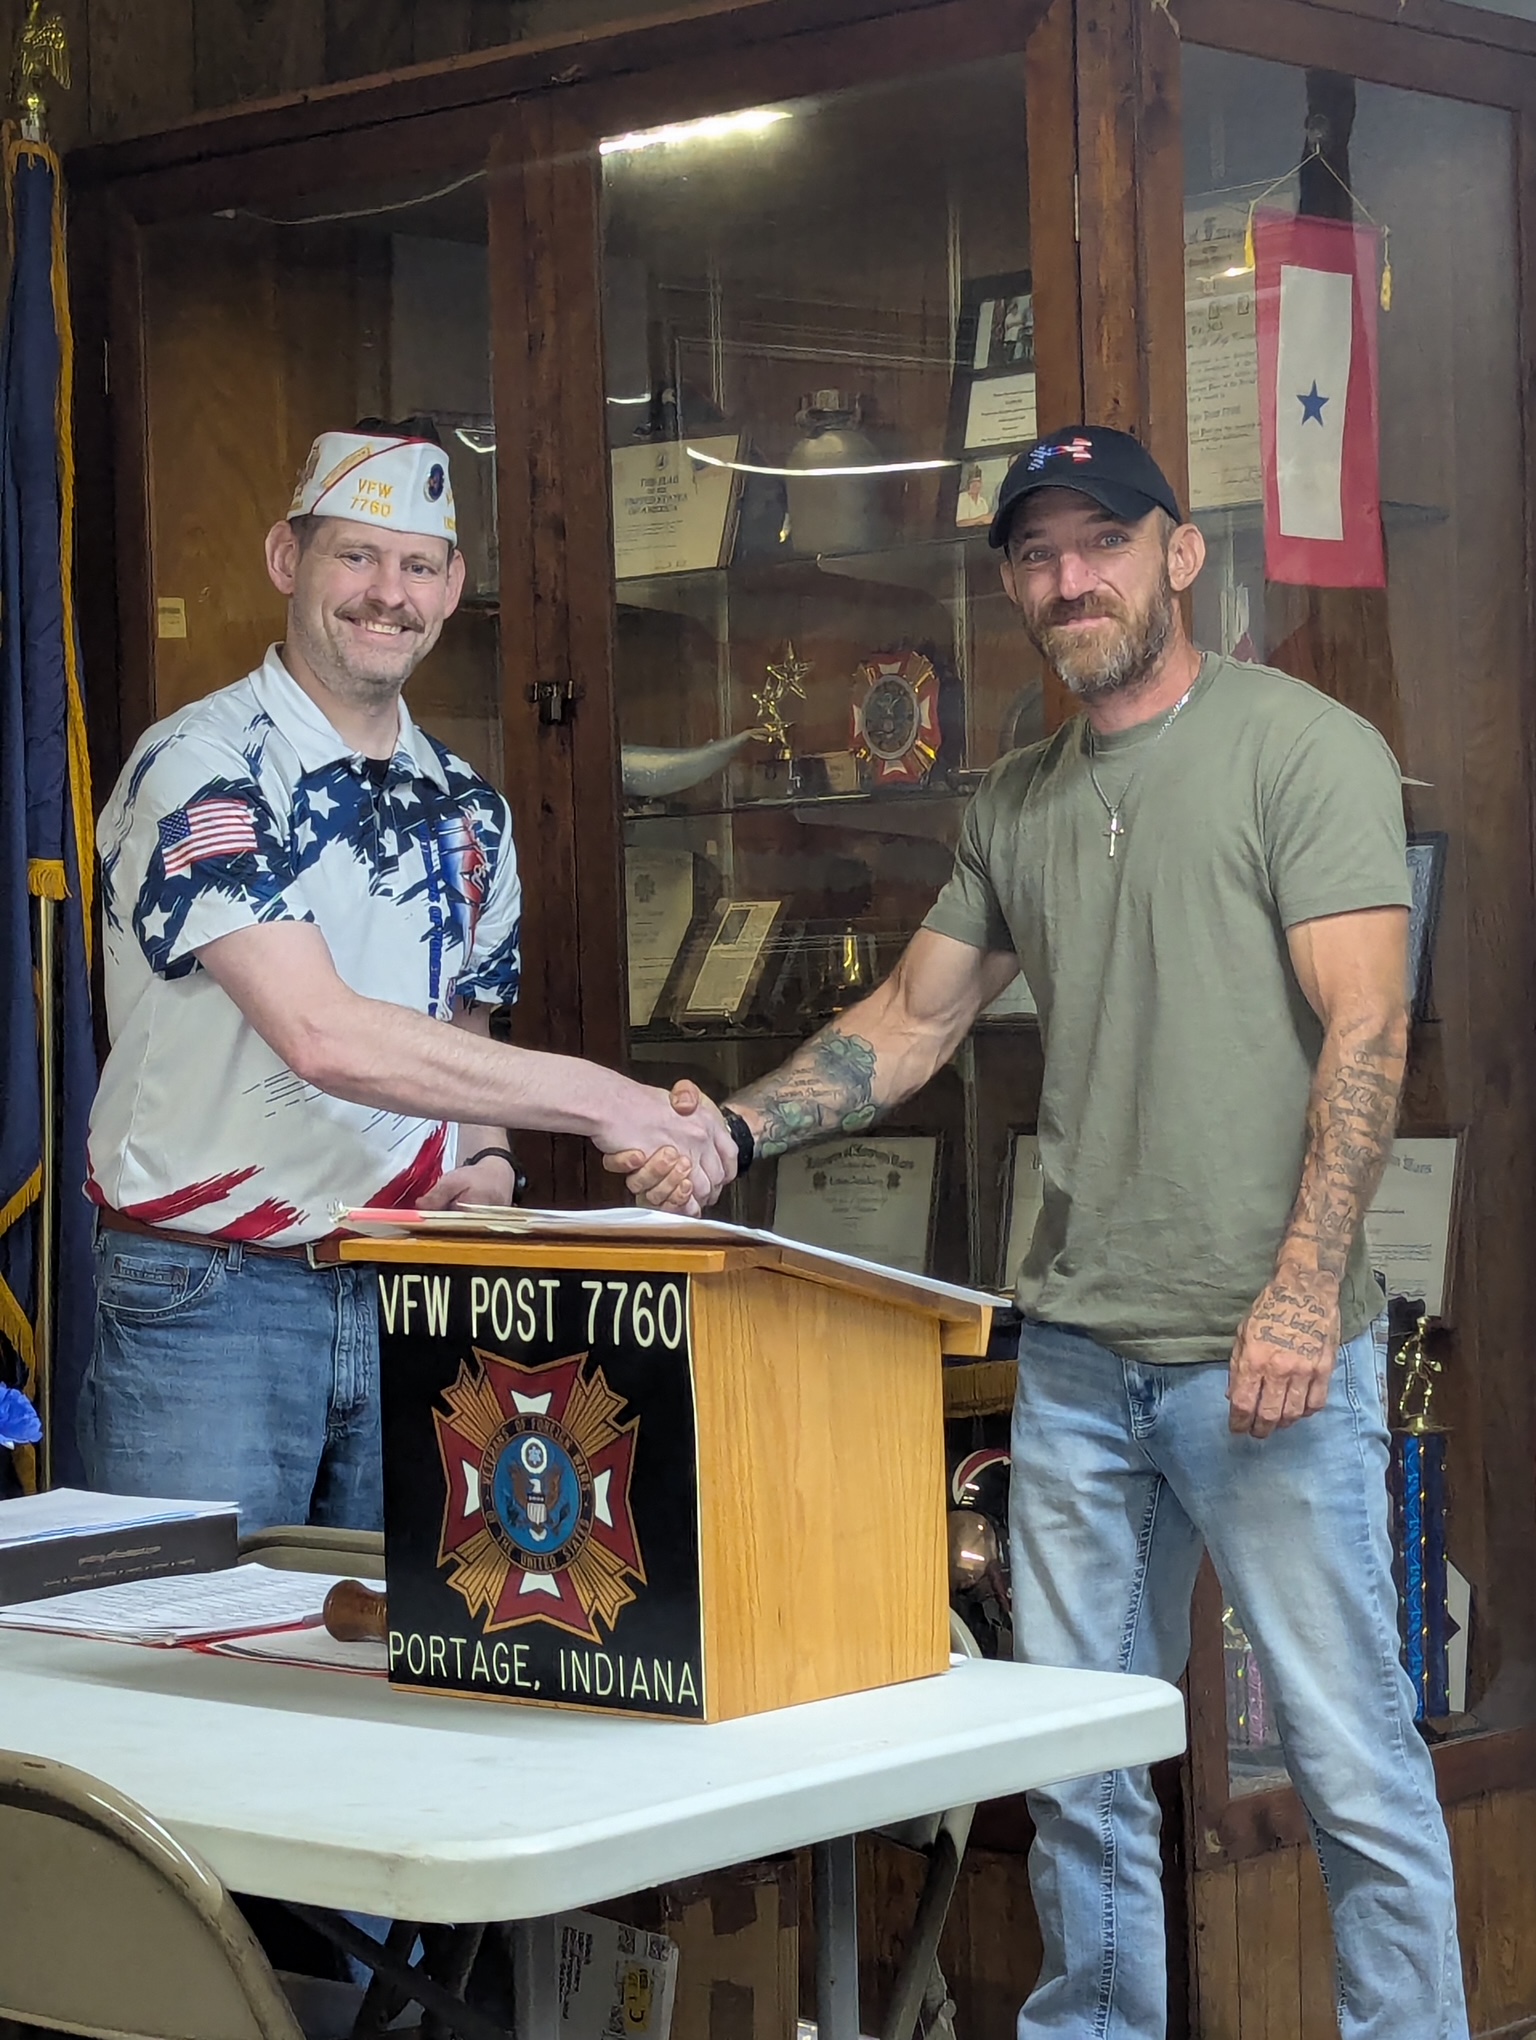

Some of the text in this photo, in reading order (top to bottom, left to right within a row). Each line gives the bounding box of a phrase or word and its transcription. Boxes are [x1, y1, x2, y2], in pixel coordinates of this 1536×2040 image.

[350, 496, 392, 517] 7760
[358, 478, 394, 499] VFW
[378, 1274, 682, 1350] VFW POST 7760
[482, 1417, 591, 1491] VETERANS OF FOREIGN WARS
[520, 1554, 557, 1571] UNITED
[563, 1519, 590, 1561] STATES
[388, 1631, 699, 1706] PORTAGE, INDIANA
